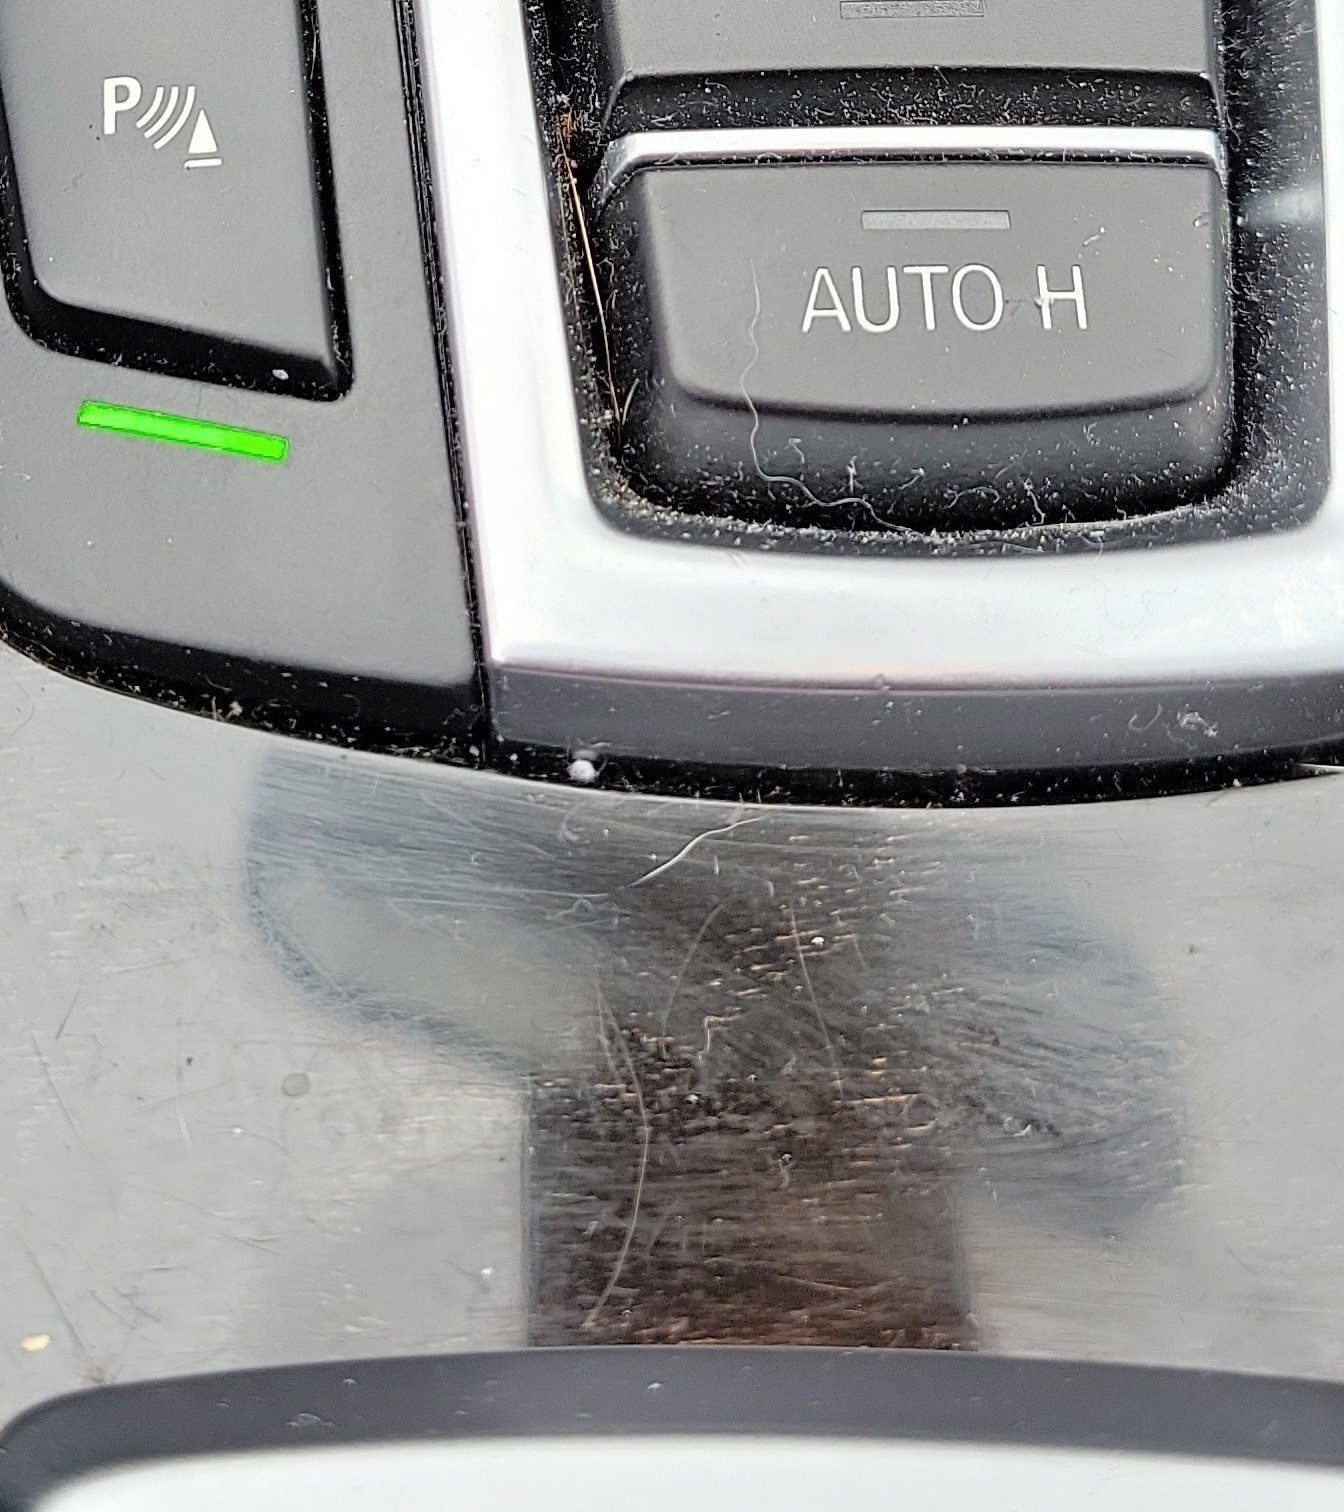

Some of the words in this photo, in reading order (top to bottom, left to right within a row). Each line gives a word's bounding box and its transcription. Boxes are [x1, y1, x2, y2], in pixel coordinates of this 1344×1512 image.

[103, 75, 142, 135] P
[802, 264, 1003, 332] AUTO
[1036, 264, 1087, 331] H
